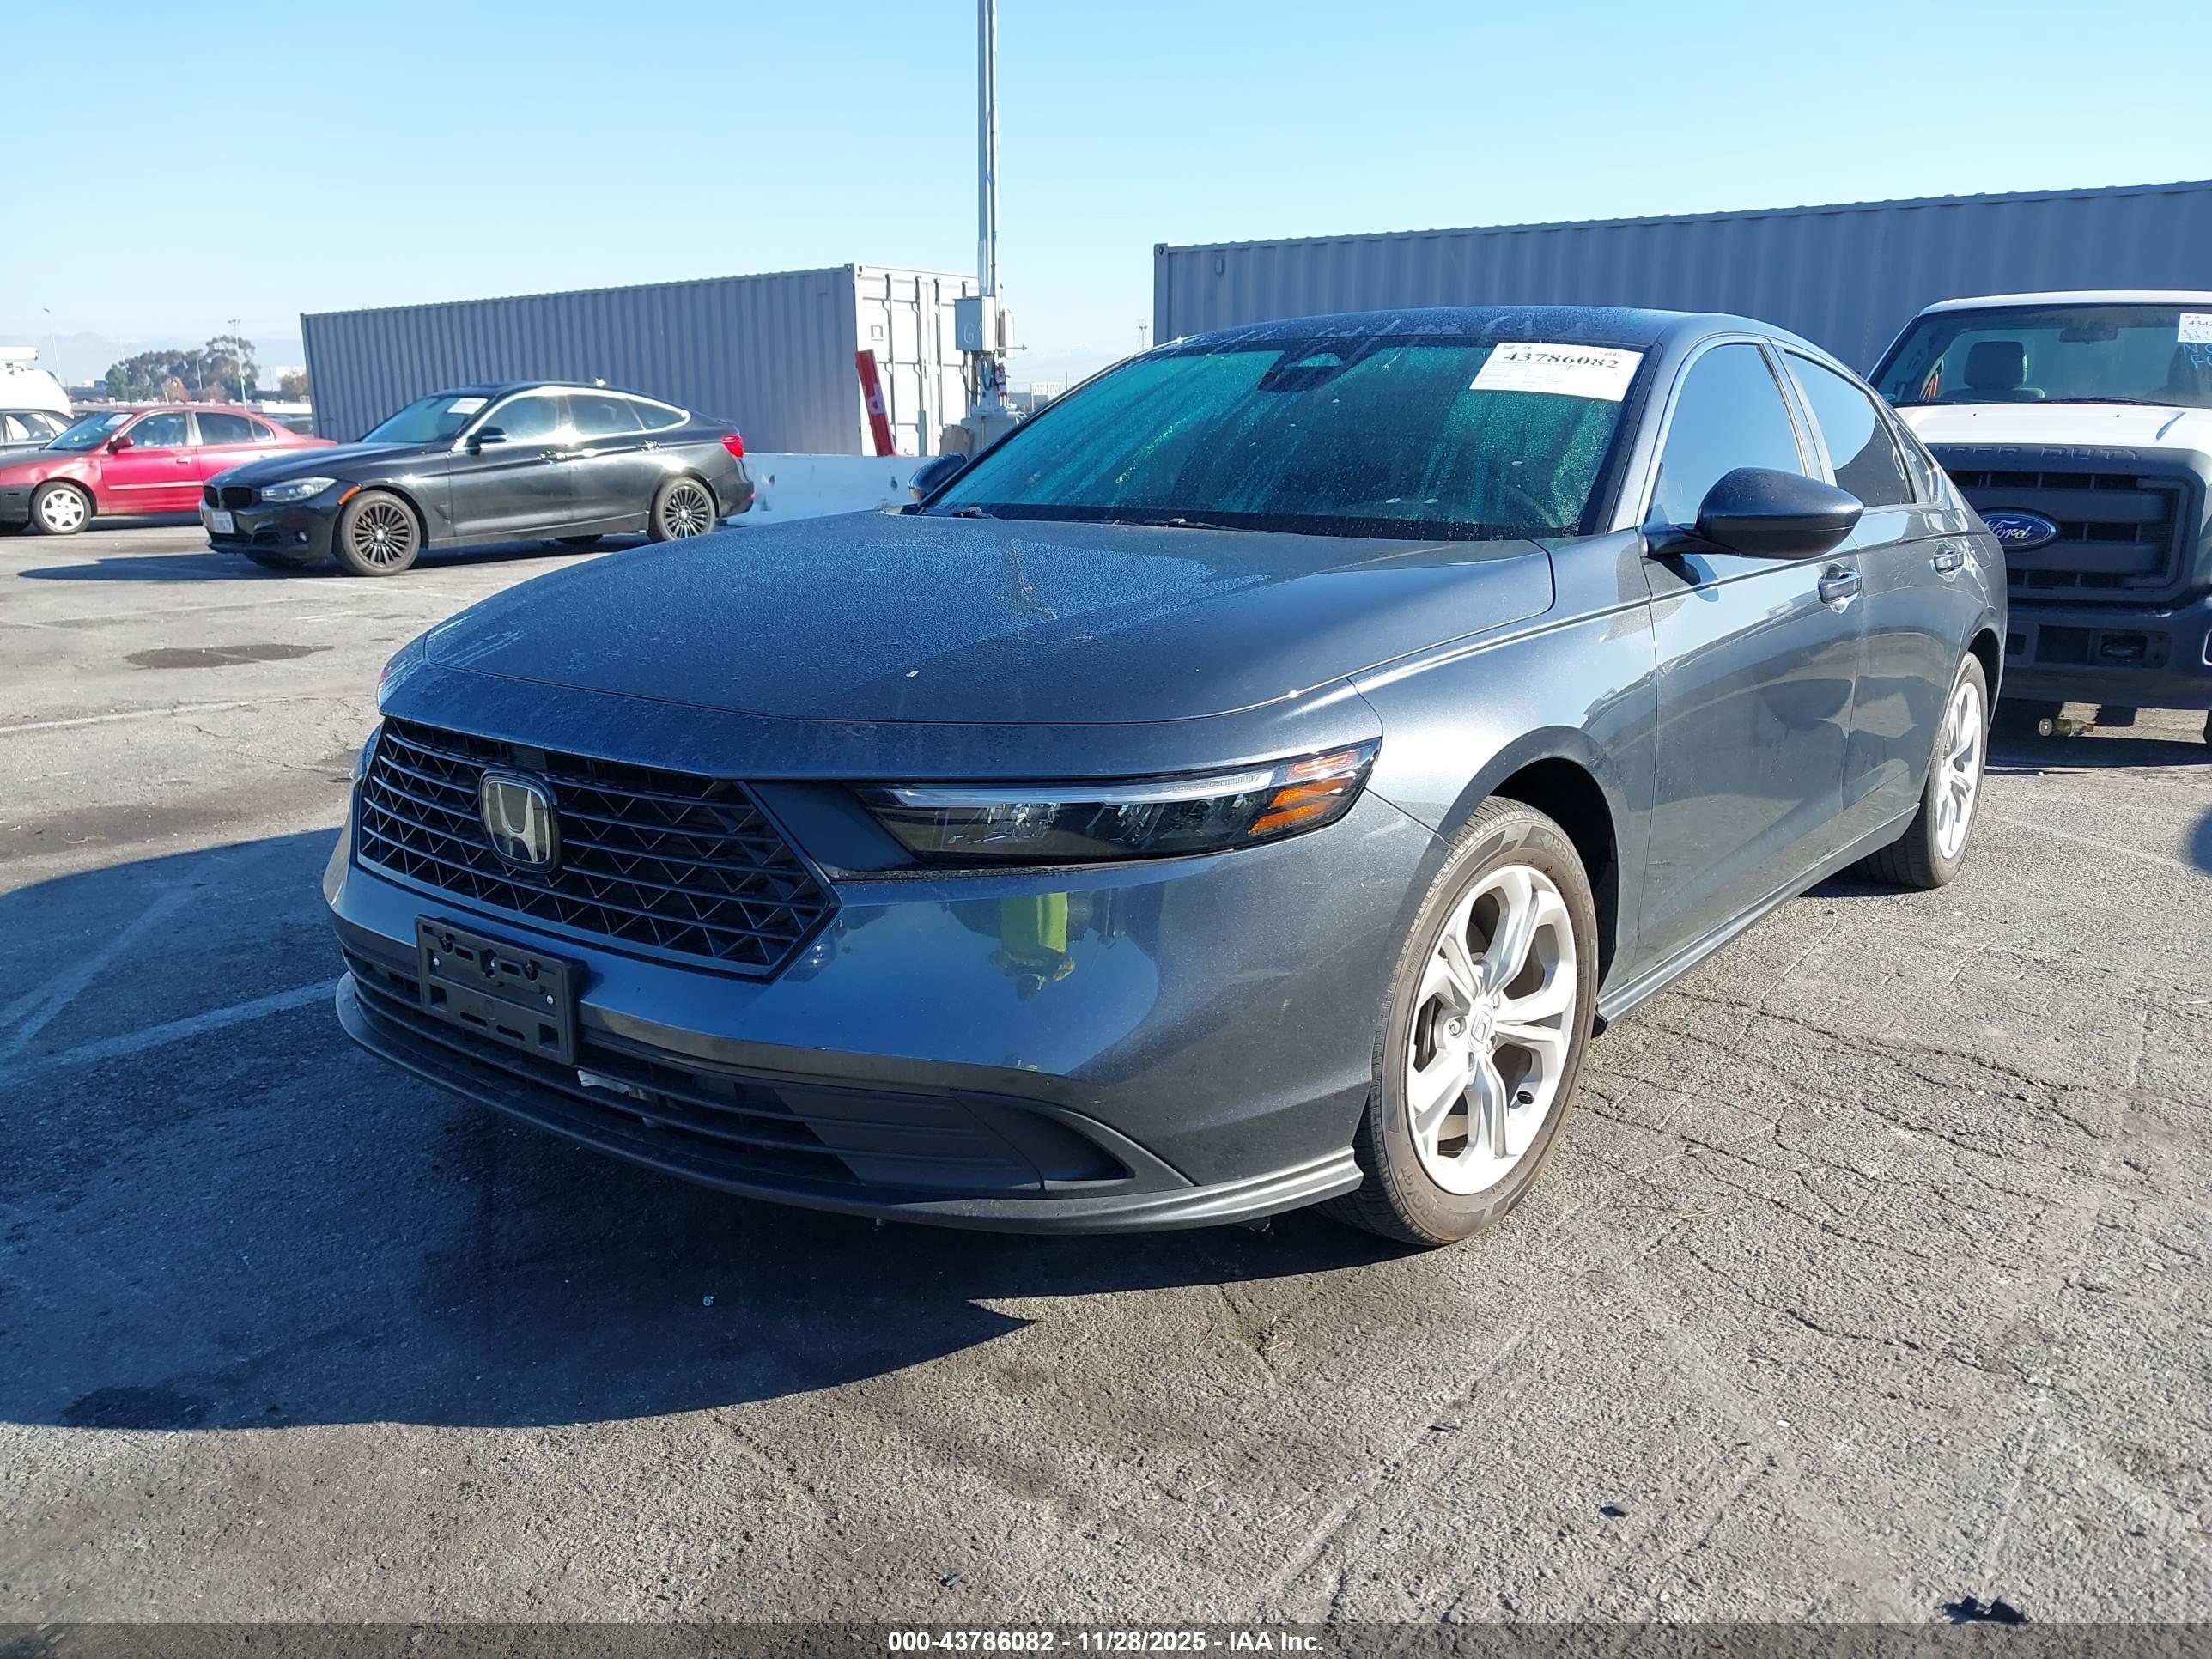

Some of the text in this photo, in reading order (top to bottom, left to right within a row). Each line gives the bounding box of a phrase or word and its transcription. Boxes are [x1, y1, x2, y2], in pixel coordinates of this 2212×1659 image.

[963, 322, 975, 344] G
[1504, 351, 1620, 369] 43786082
[1986, 518, 2033, 539] Ford
